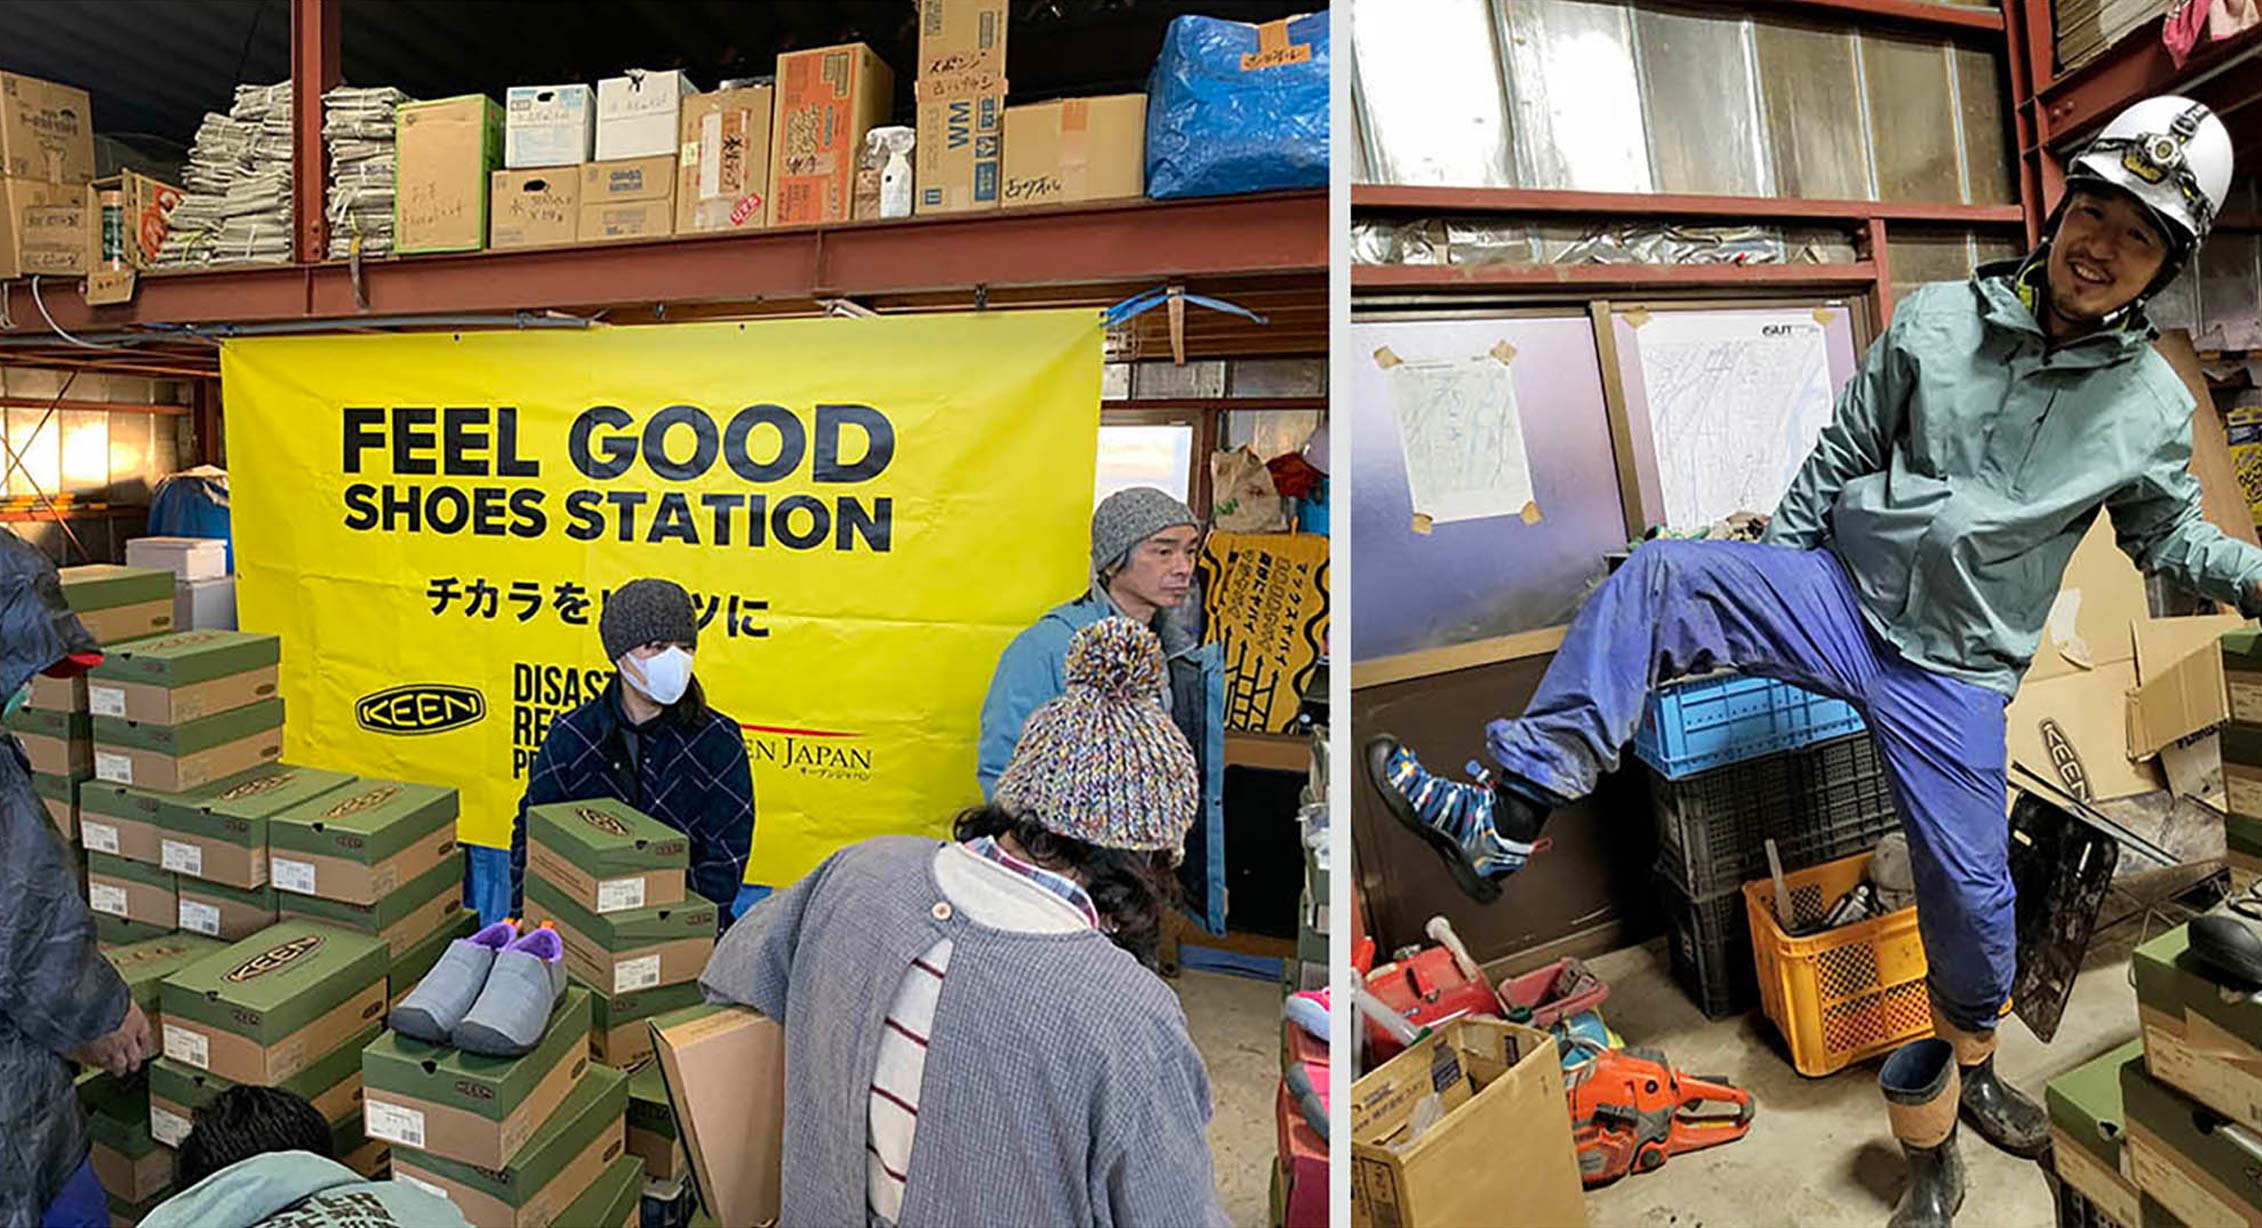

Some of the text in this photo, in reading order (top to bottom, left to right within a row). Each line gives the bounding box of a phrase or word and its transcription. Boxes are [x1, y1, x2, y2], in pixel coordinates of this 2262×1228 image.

[930, 53, 987, 75] スポンジ
[947, 101, 972, 150] WM
[342, 403, 895, 483] FEEL GOOD
[342, 484, 892, 553] SHOES STATION
[426, 576, 770, 639] チカラをツに
[362, 692, 478, 727] KEEN
[513, 705, 562, 747] RE
[744, 735, 873, 770] EN JAPAN
[2042, 723, 2091, 804] KEEN
[230, 936, 319, 980] KEEN
